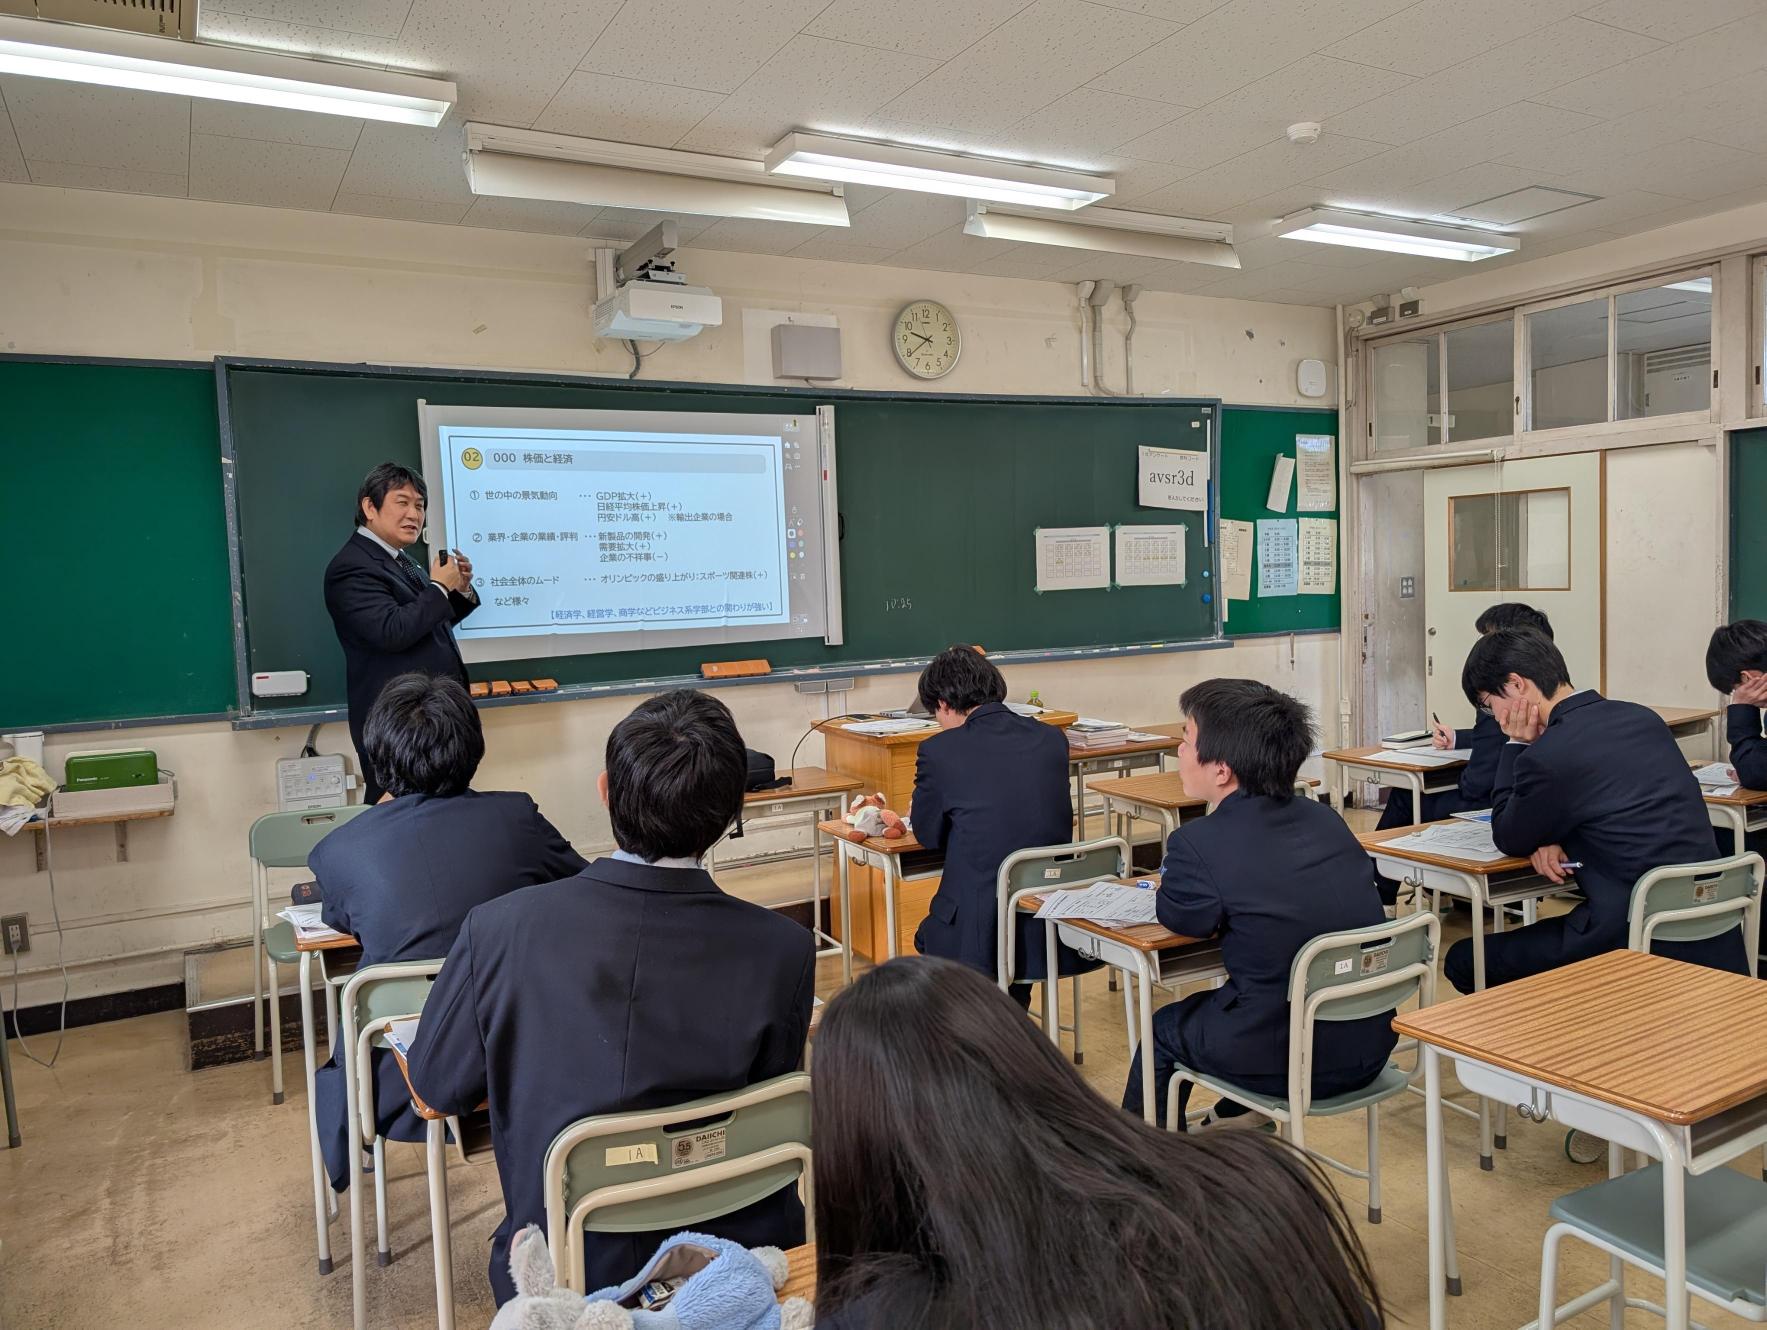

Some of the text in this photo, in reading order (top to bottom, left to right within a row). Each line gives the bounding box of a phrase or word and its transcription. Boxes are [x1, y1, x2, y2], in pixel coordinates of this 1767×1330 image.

[463, 451, 480, 462] 02
[523, 453, 574, 465] 株価と経済
[1149, 469, 1194, 486] avsr3d
[485, 490, 558, 501] 世の中の景気動向
[596, 491, 652, 501] GDP拡大(+)
[597, 502, 683, 512] 日経平均株価上昇(+)
[597, 512, 657, 523] 円安ドル高(+)
[599, 542, 651, 552] 需要拡大(+)
[490, 575, 560, 587] 社会全体のムード
[494, 596, 530, 606] など様々
[695, 1130, 725, 1142] DAIICHI
